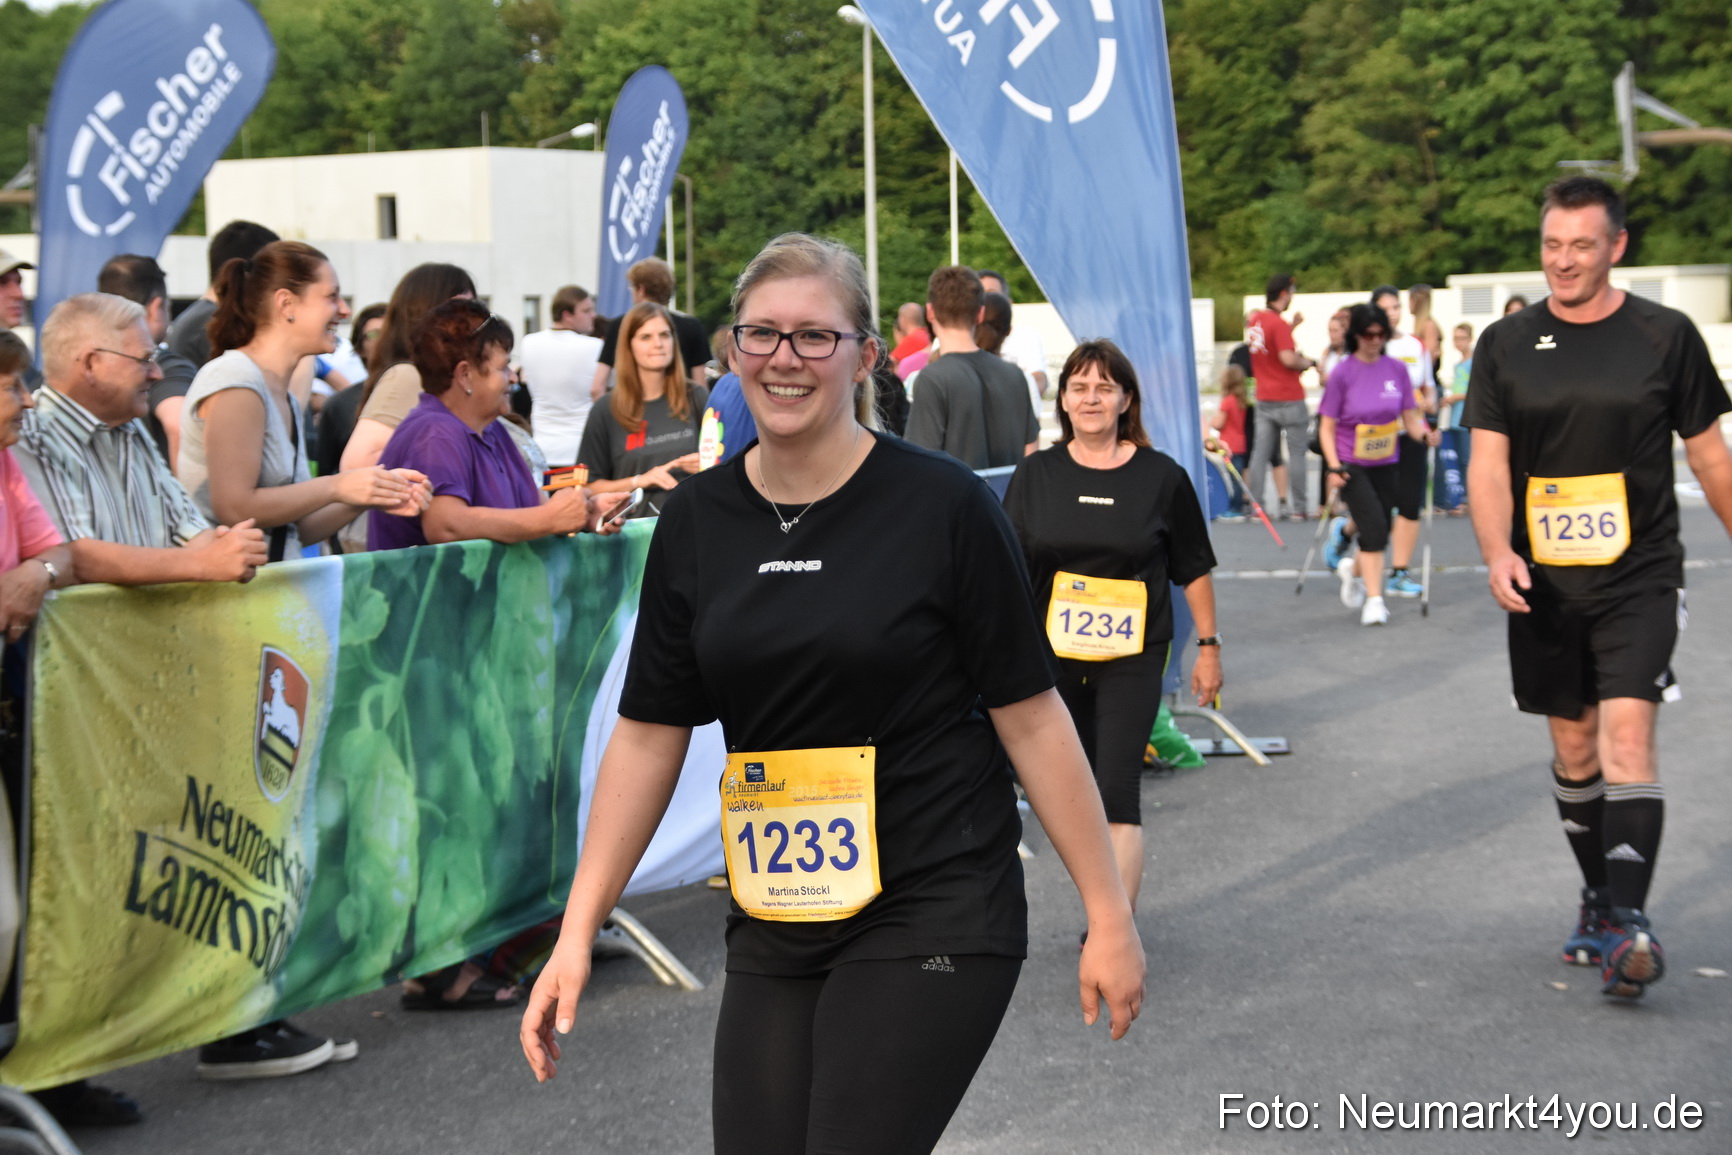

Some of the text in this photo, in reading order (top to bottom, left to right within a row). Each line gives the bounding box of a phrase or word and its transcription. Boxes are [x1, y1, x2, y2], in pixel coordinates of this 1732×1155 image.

[97, 22, 229, 206] Fischer
[144, 60, 243, 206] AUTOMOBILE
[1538, 511, 1617, 540] 1236
[758, 560, 822, 574] STANNO
[1060, 608, 1134, 640] 1234
[738, 779, 786, 793] firmenlauf
[727, 799, 764, 812] walken
[178, 774, 311, 900] Neumarkt
[738, 817, 859, 874] 1233
[124, 830, 291, 980] Lammsb
[768, 885, 830, 896] Martina Stöckl
[921, 963, 955, 973] adidas
